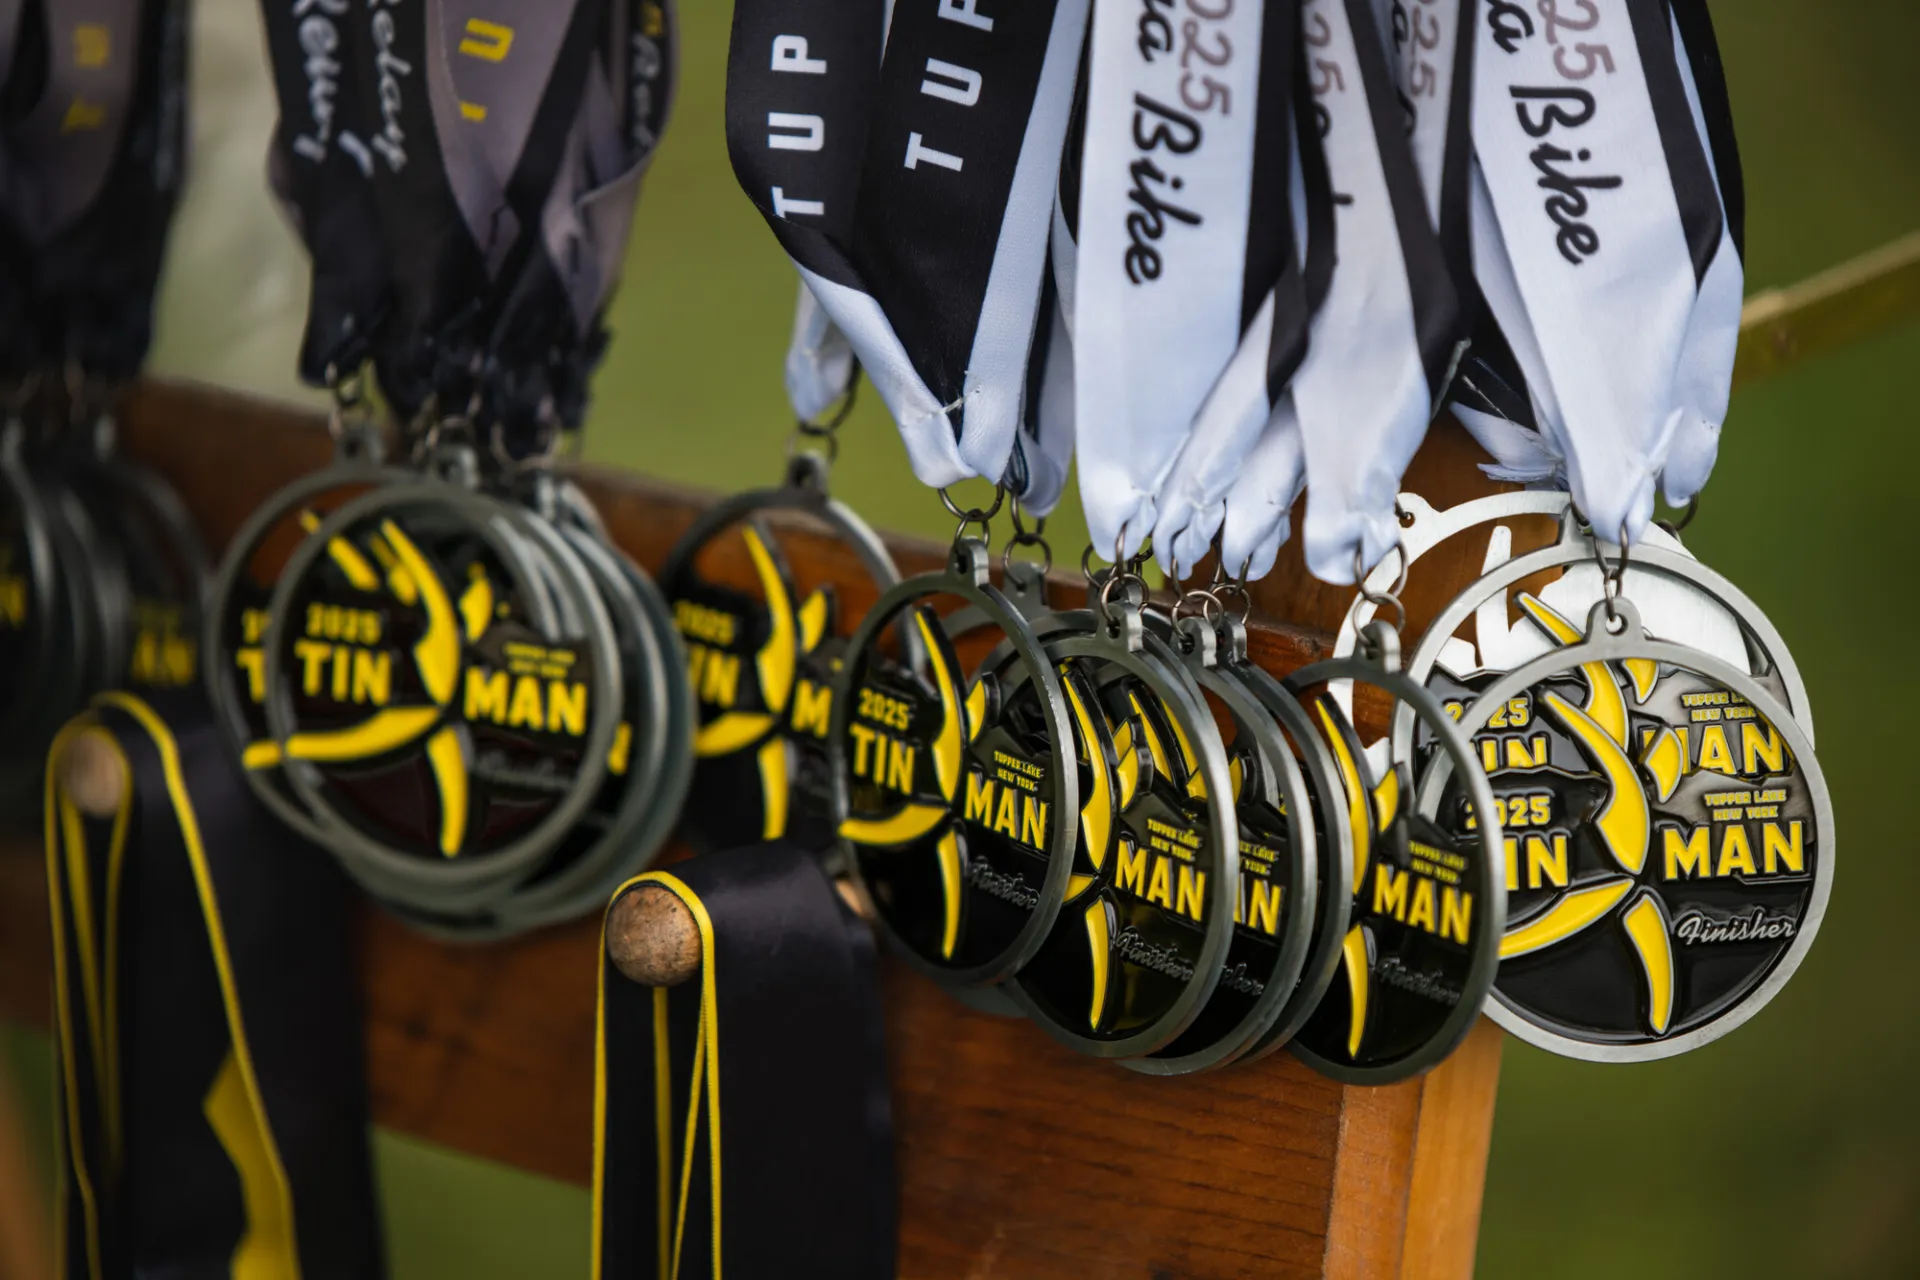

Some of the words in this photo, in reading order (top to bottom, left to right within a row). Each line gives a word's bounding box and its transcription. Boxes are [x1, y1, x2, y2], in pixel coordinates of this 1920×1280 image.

[767, 33, 827, 218] TUP
[1125, 92, 1204, 285] Bike
[1508, 85, 1623, 266] Bike
[294, 637, 391, 706] TIN
[464, 664, 588, 736] MAN
[1682, 692, 1729, 707] TUPPER
[858, 686, 911, 732] 2025
[1444, 696, 1529, 729] 225
[1691, 708, 1721, 722] NEW
[1723, 706, 1757, 720] YORK
[849, 722, 915, 795] TIN
[993, 750, 1021, 770] TUPPER
[1021, 761, 1042, 778] LAKE
[997, 767, 1016, 783] NEW
[1016, 775, 1037, 792] YORK
[964, 770, 1047, 850] MAN
[1704, 792, 1751, 806] TUPPER
[1753, 789, 1787, 802] LAKE
[1712, 807, 1743, 821] NEW
[1747, 805, 1779, 819] YORK
[1662, 820, 1805, 880] MAN
[1115, 839, 1206, 922] MAN
[1372, 862, 1473, 945] MAN
[1677, 912, 1796, 945] Finisher
